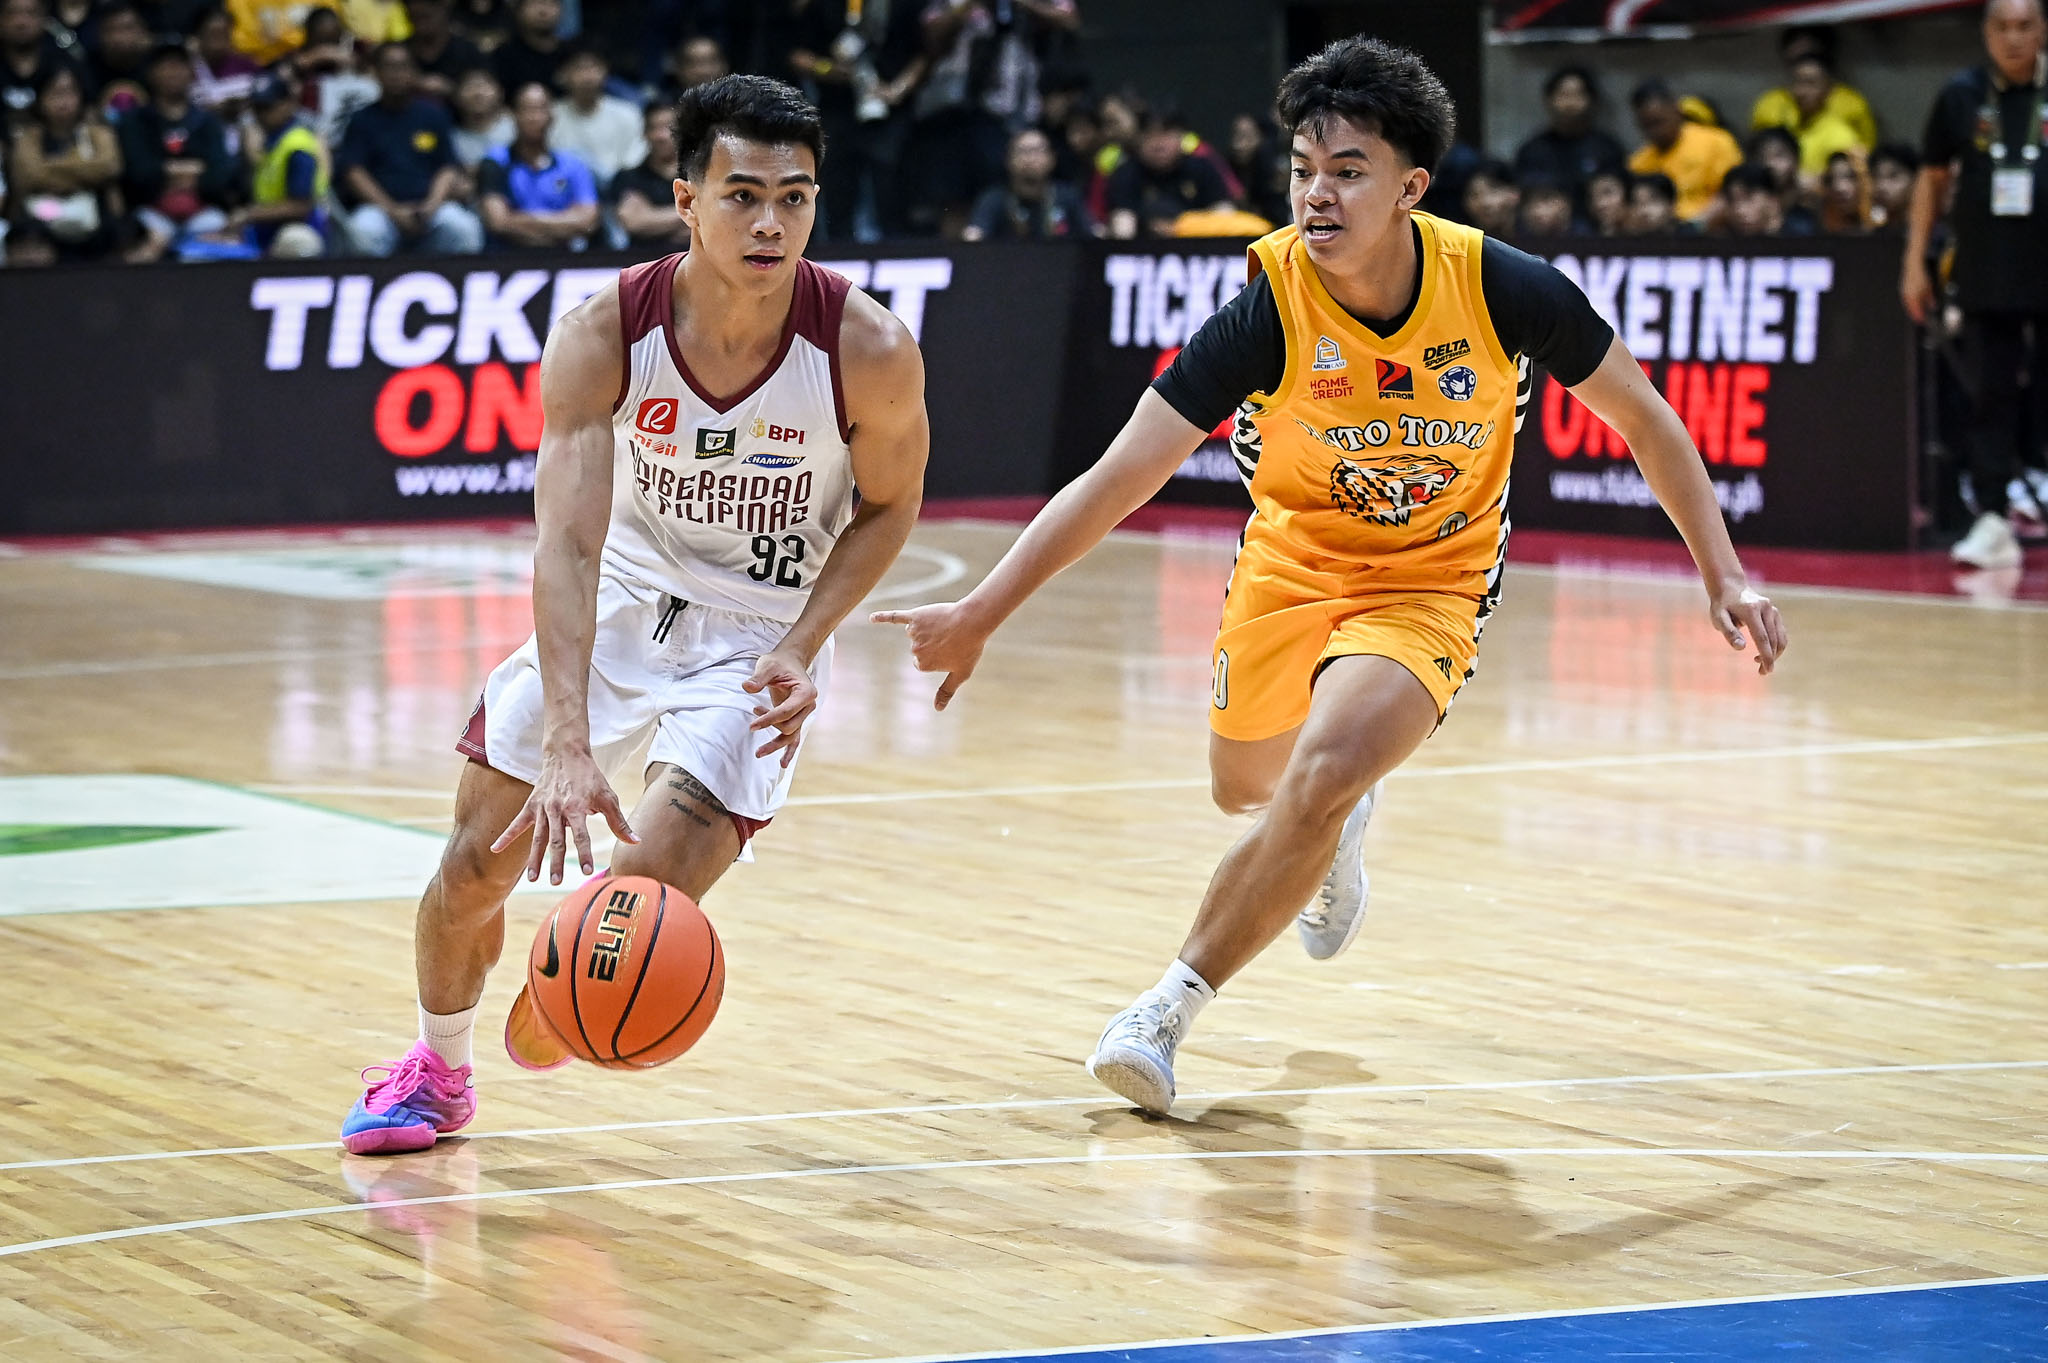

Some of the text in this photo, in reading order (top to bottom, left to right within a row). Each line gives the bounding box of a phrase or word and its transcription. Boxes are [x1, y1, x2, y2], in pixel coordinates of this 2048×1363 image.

[1423, 338, 1470, 362] DELTA
[1424, 348, 1471, 368] SPORTSWEAR
[1310, 376, 1349, 390] HOME
[1313, 386, 1354, 401] CREDIT
[1379, 391, 1415, 400] PETRON
[768, 424, 805, 445] BPI
[745, 454, 802, 465] CHAMPION
[746, 534, 806, 588] 92
[587, 890, 639, 983] ELITE
